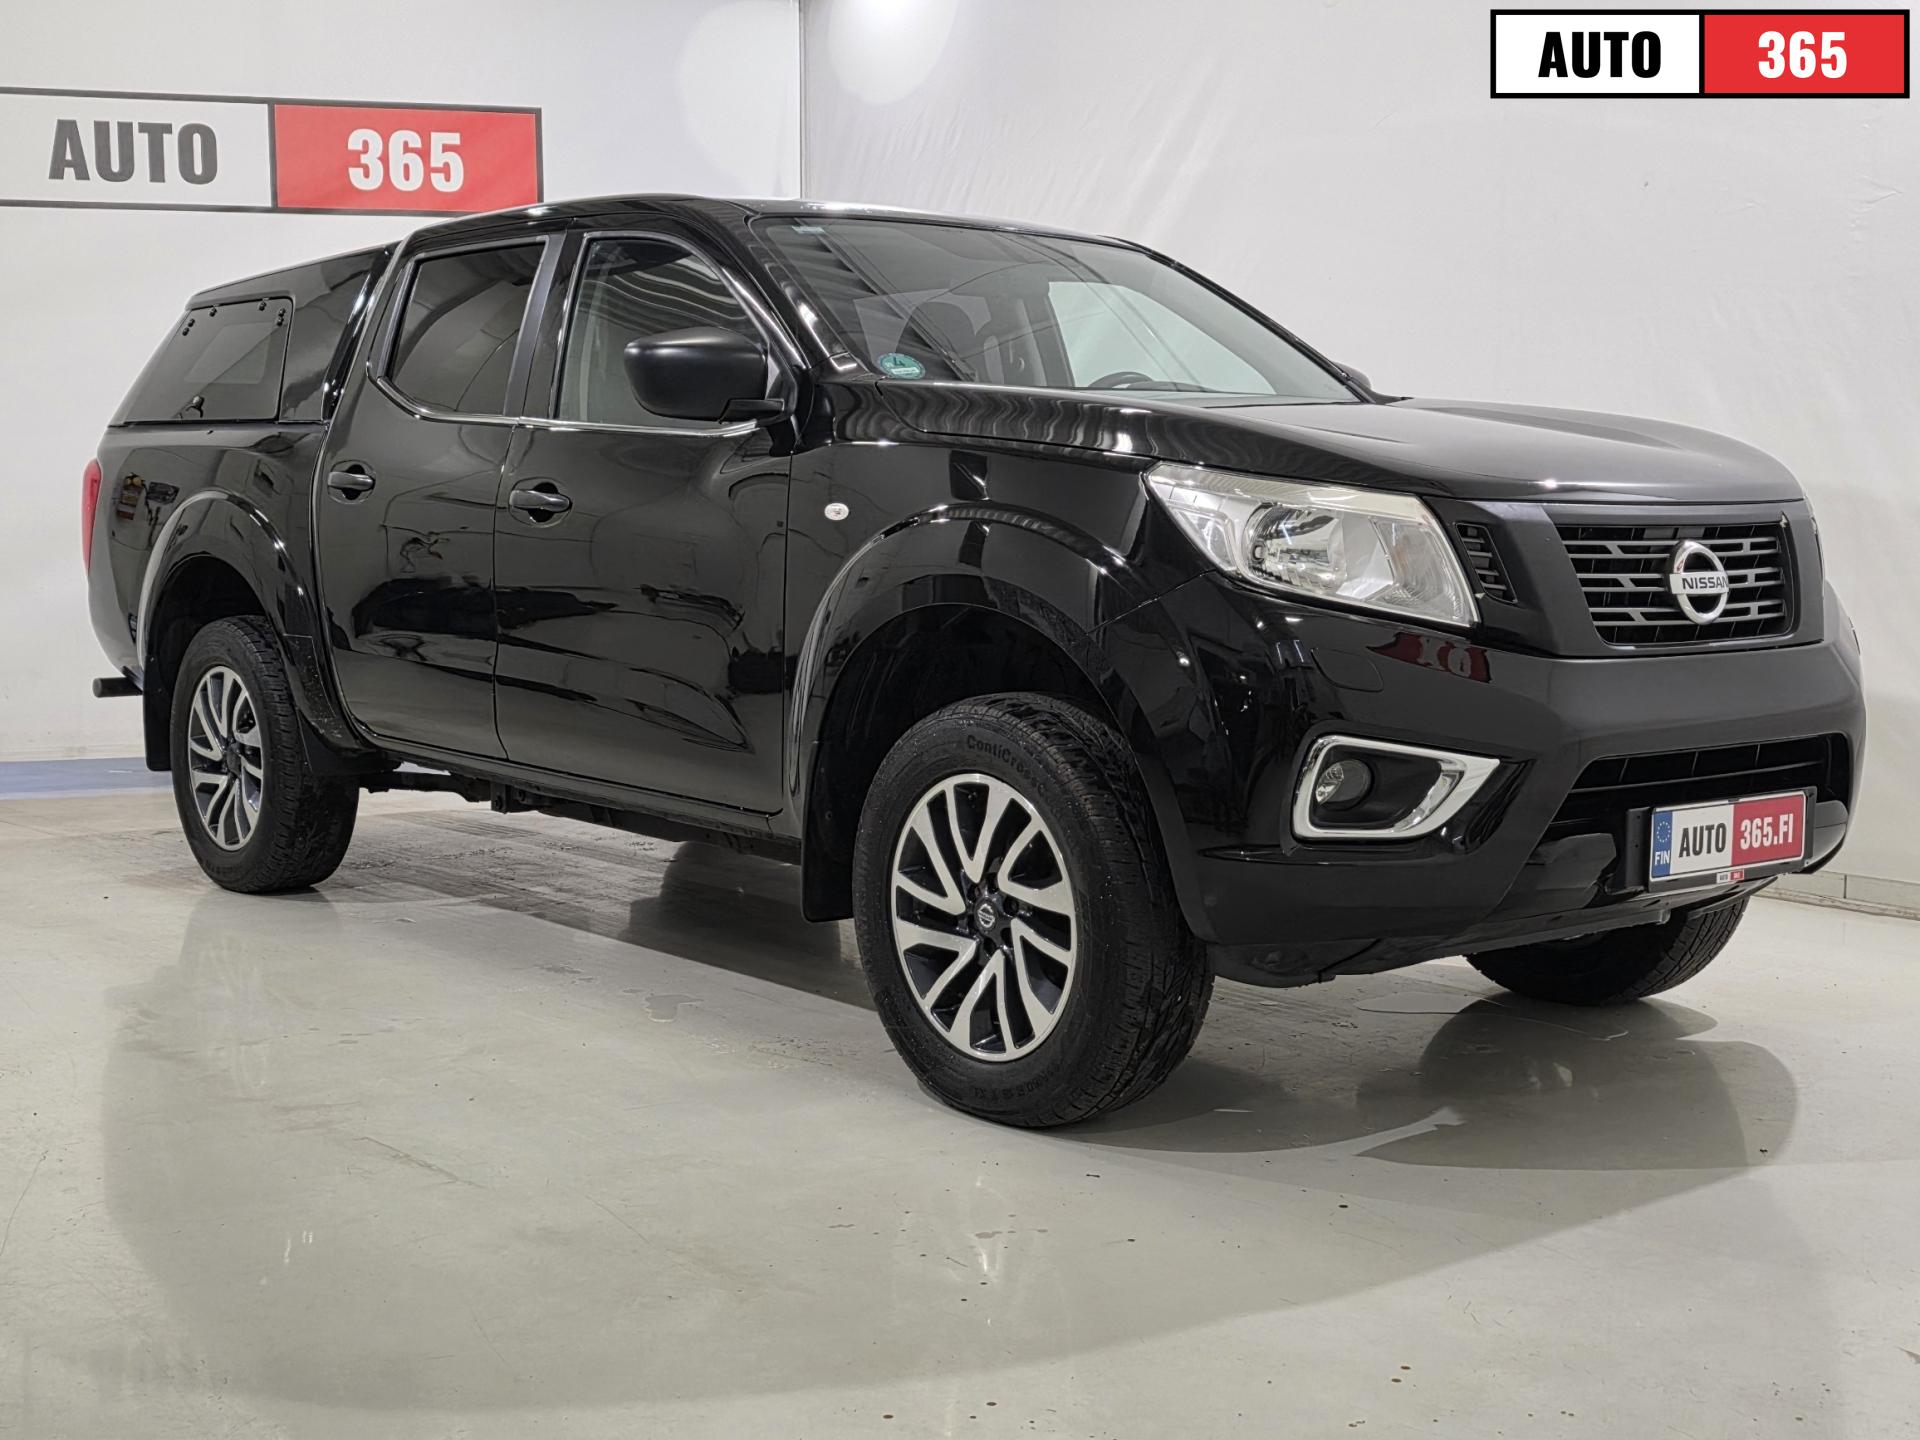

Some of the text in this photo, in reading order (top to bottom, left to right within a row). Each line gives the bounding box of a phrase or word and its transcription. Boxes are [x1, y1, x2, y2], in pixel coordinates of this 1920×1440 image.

[48, 118, 465, 193] AUTO 365
[1681, 575, 1729, 590] NISSAN
[1678, 813, 1794, 858] AUTO 365.FI
[1654, 850, 1671, 867] FIN
